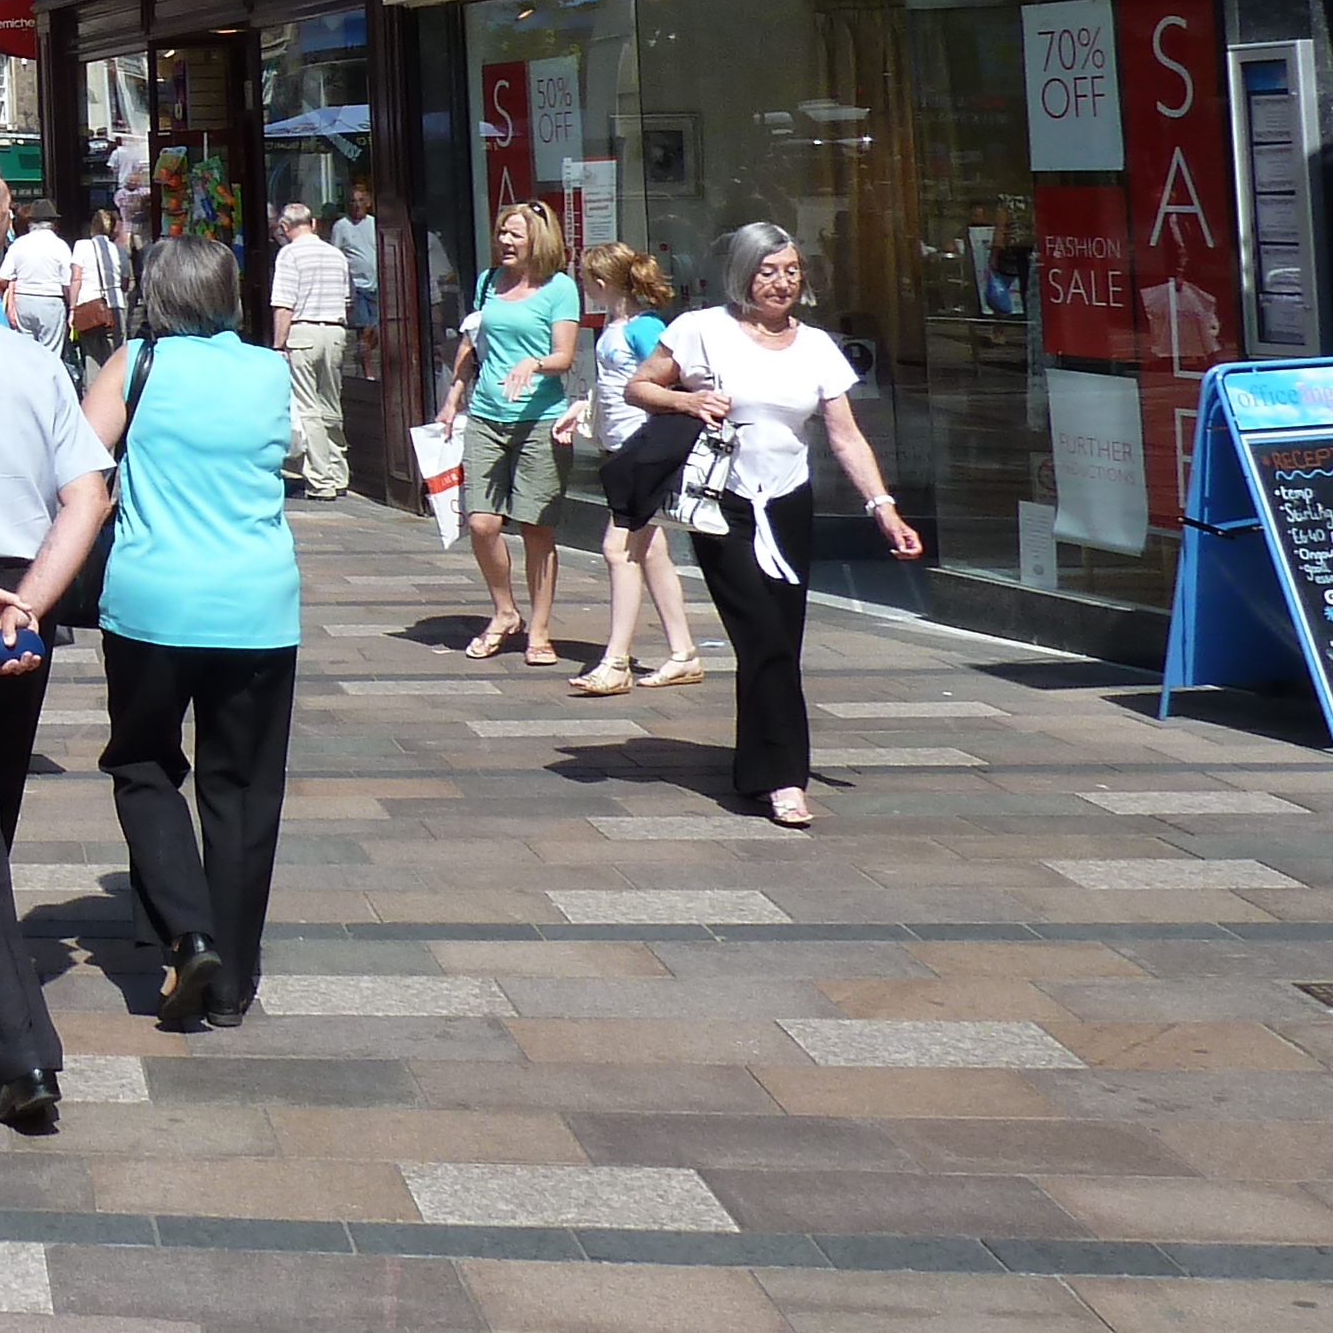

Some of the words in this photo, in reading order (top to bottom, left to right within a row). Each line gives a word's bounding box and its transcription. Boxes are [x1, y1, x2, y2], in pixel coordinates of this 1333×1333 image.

[1037, 26, 1106, 72] 70%
[536, 76, 572, 110] 50%
[1041, 75, 1106, 119] OFF
[538, 111, 573, 144] OFF
[1044, 234, 1122, 259] FASHION
[1048, 267, 1125, 308] SALE
[1058, 432, 1135, 464] FURTHER
[1281, 486, 1314, 504] temp
